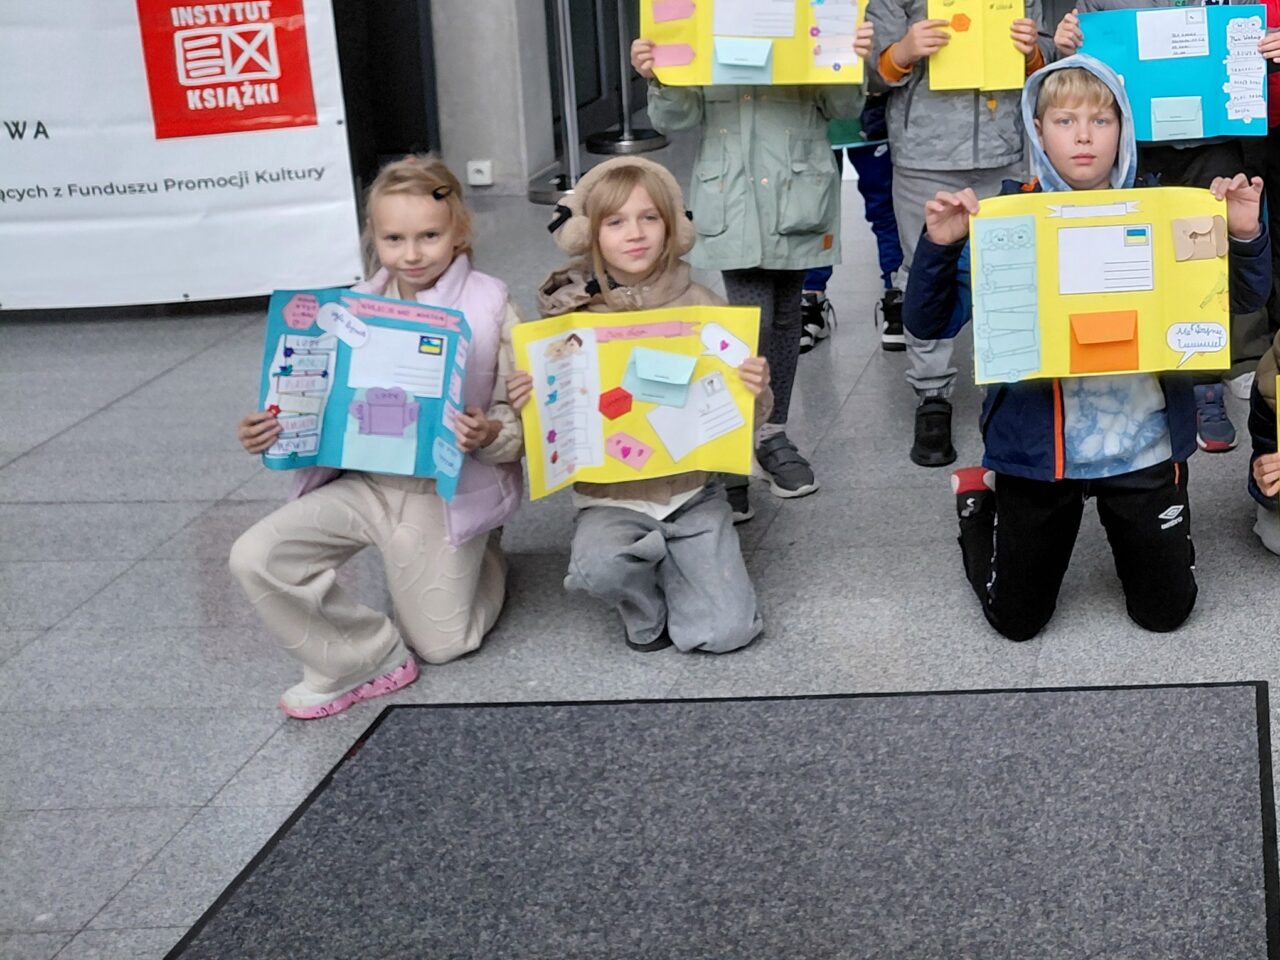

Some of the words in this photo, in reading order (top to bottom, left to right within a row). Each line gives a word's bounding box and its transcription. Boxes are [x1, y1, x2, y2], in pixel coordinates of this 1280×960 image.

[170, 0, 272, 27] INSTYTUT
[186, 80, 280, 111] KSIĄŻKI
[53, 186, 63, 198] z
[67, 179, 158, 198] Funduszu
[164, 170, 250, 193] Promocji
[255, 165, 326, 185] Kultury
